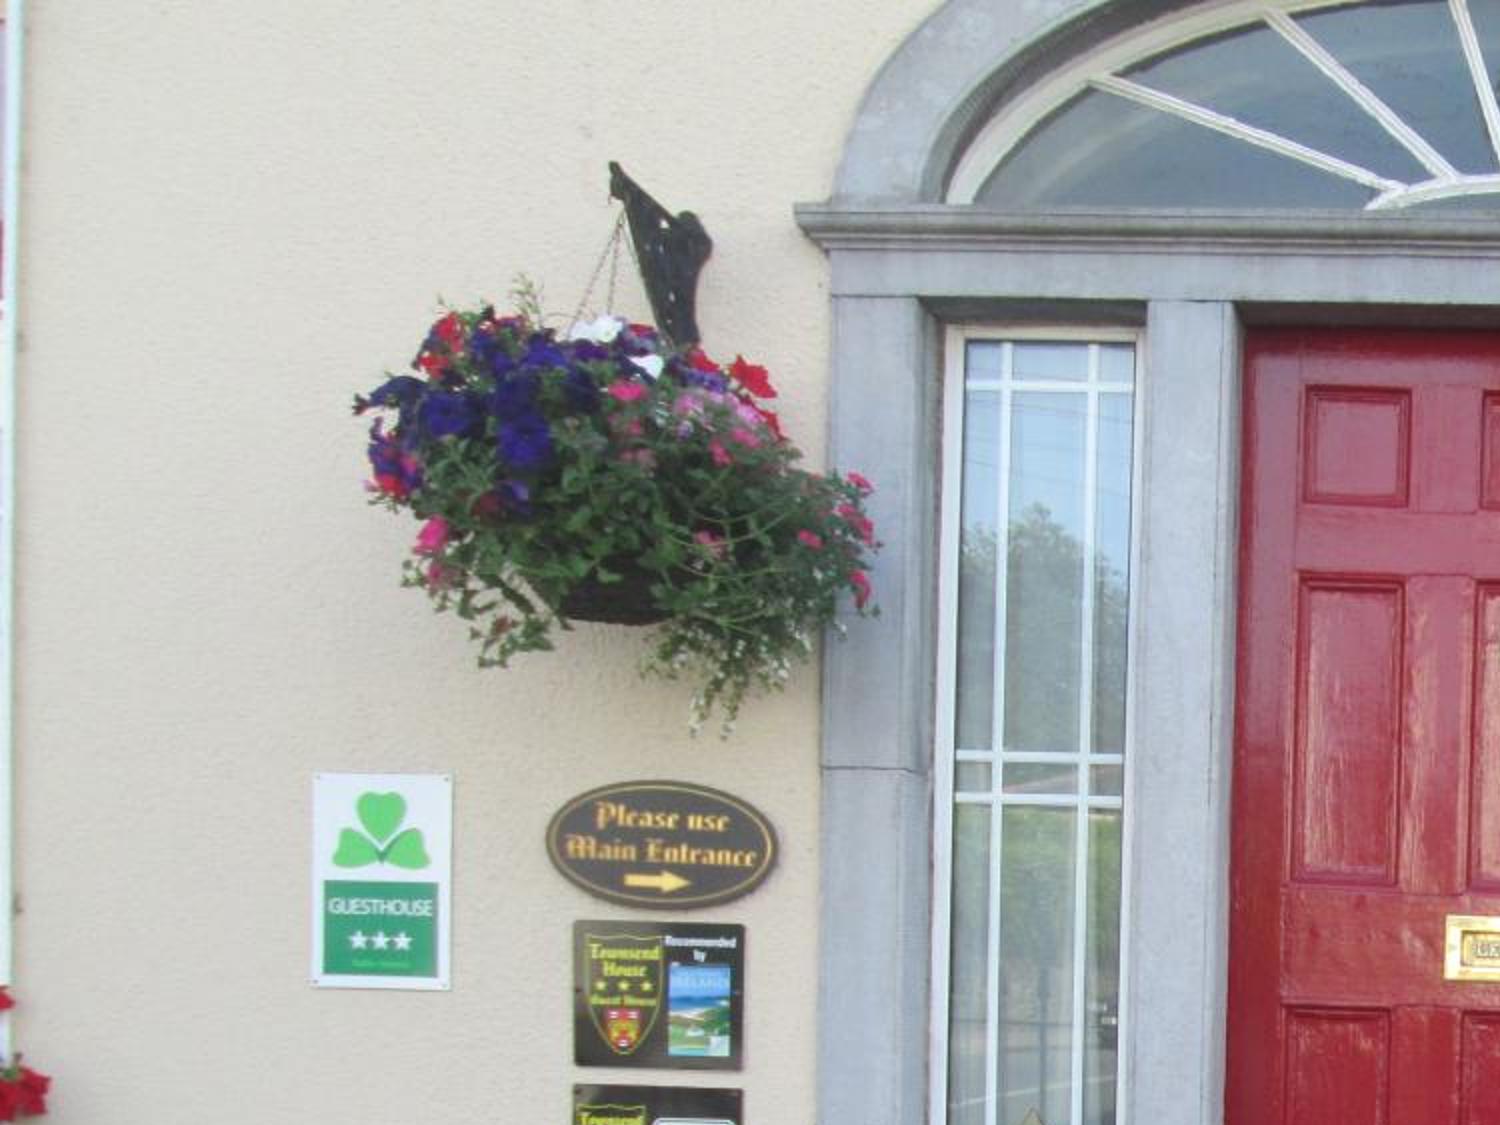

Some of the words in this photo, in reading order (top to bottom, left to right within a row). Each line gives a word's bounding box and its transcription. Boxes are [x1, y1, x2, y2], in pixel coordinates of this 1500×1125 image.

[594, 800, 680, 831] Please
[687, 813, 731, 832] use
[566, 833, 638, 861] Main
[646, 838, 758, 867] Entrance
[328, 897, 433, 917] GUESTHOUSE
[589, 943, 661, 960] Townsend
[692, 949, 707, 962] by
[603, 960, 648, 977] House
